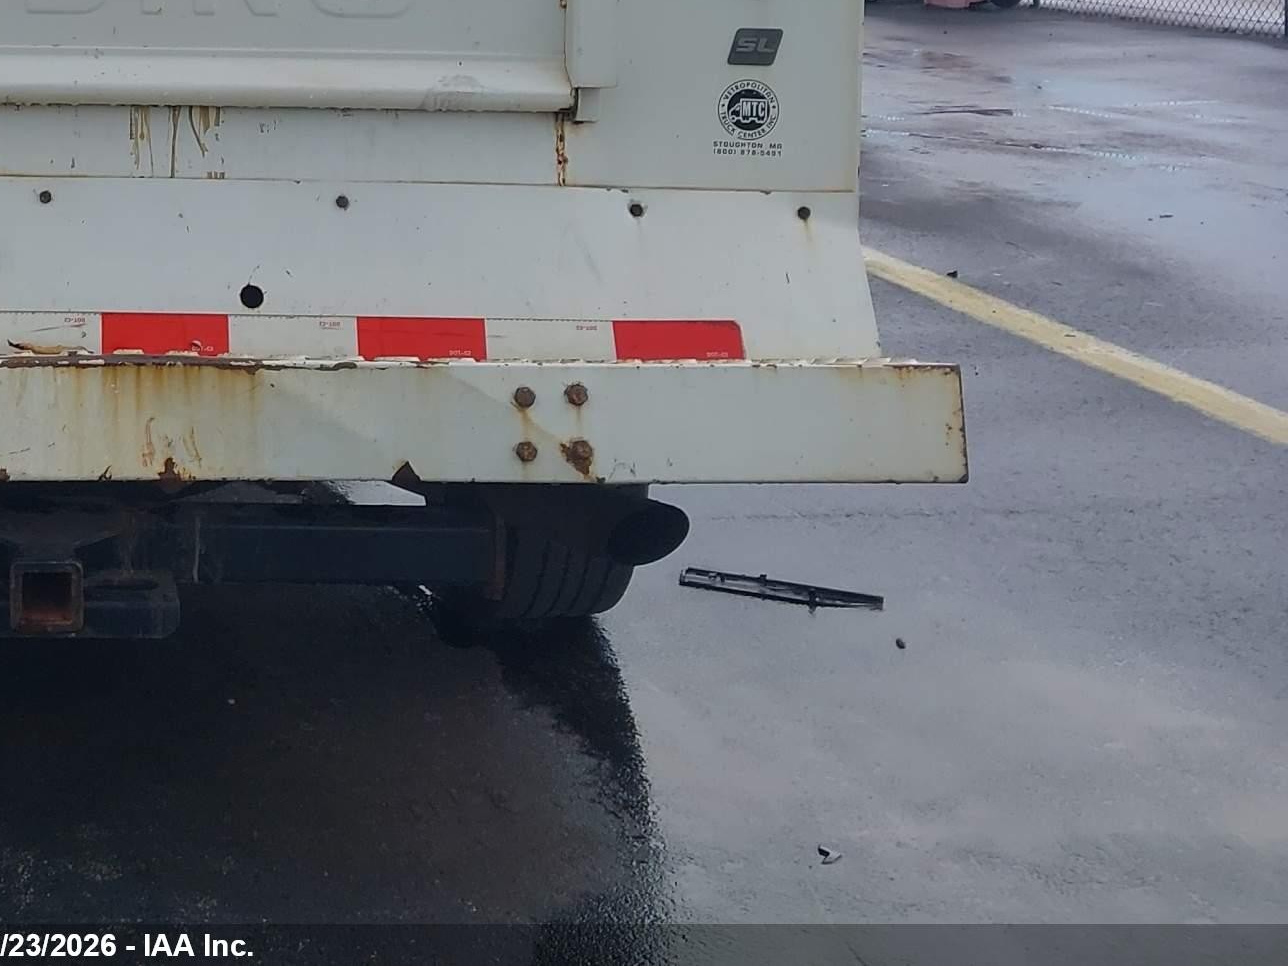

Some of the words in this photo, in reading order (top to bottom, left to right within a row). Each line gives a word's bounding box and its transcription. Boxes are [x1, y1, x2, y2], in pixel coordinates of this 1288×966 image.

[736, 38, 775, 53] SL
[722, 81, 776, 104] METROPOLITAN
[742, 101, 765, 117] MTC
[720, 111, 737, 135] TRUCK
[737, 128, 766, 138] CENTER
[713, 141, 763, 149] STOUGHTON
